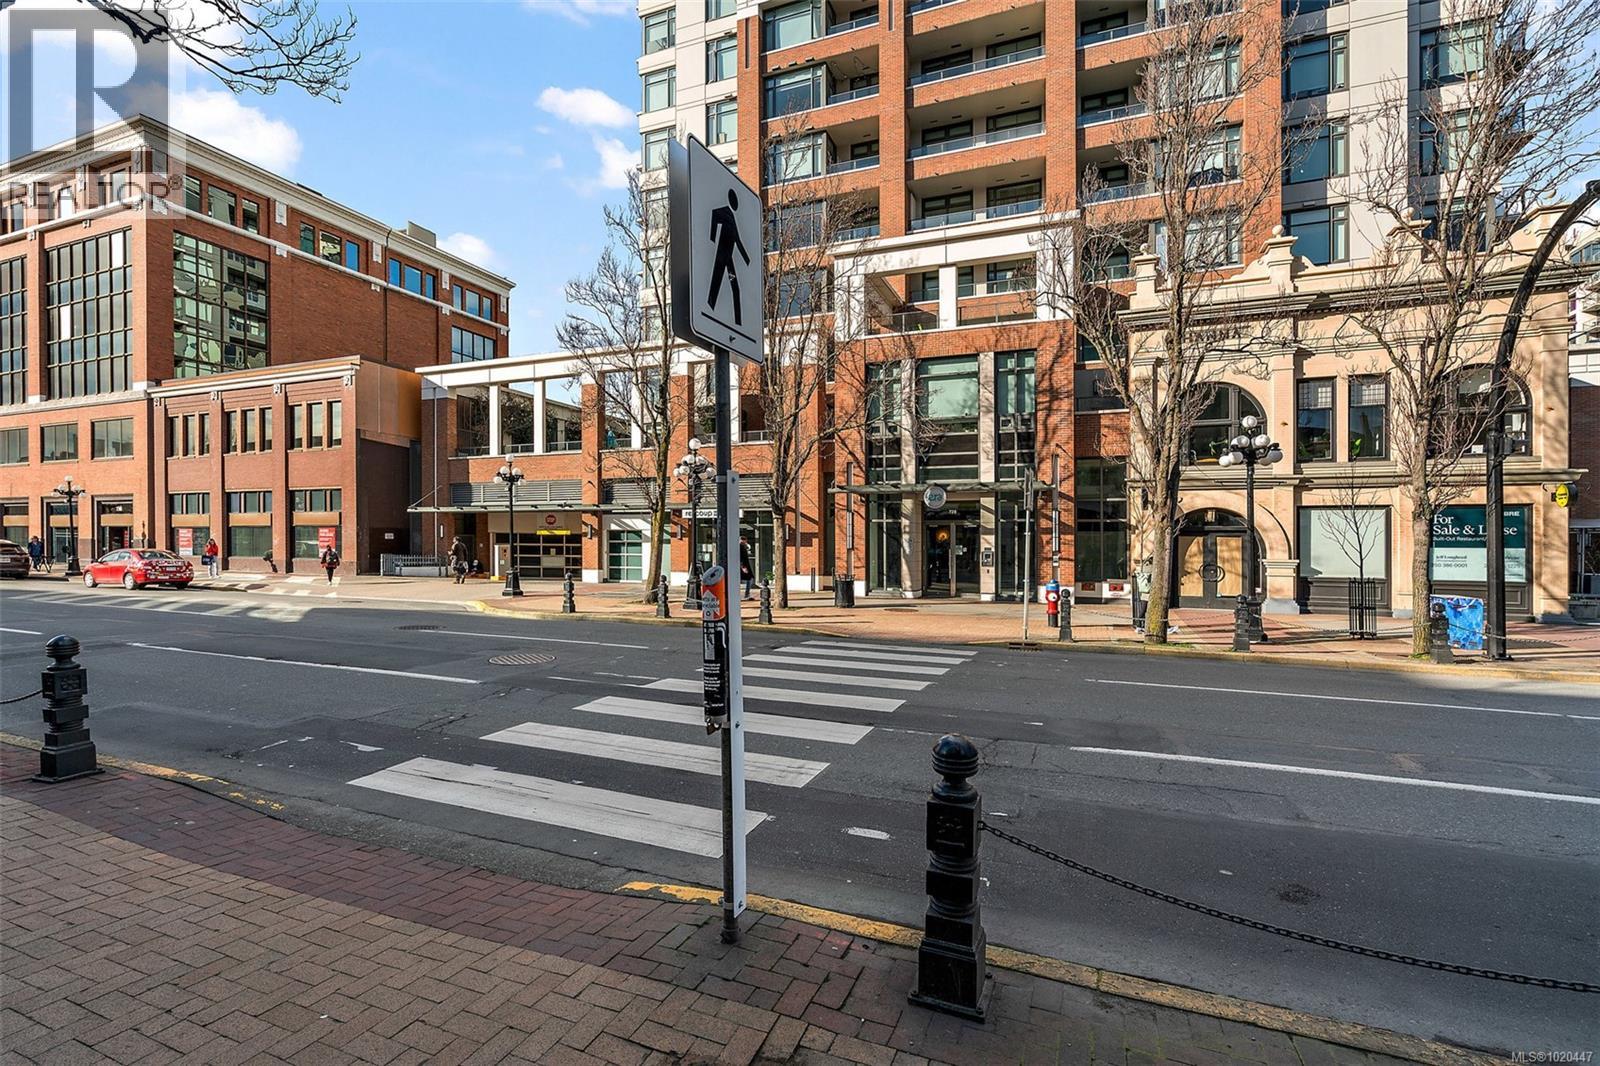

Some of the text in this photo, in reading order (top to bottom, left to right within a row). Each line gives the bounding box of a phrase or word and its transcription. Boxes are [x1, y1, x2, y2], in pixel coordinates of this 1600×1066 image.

[1433, 514, 1455, 525] For
[1432, 524, 1518, 535] Sale & Lse
